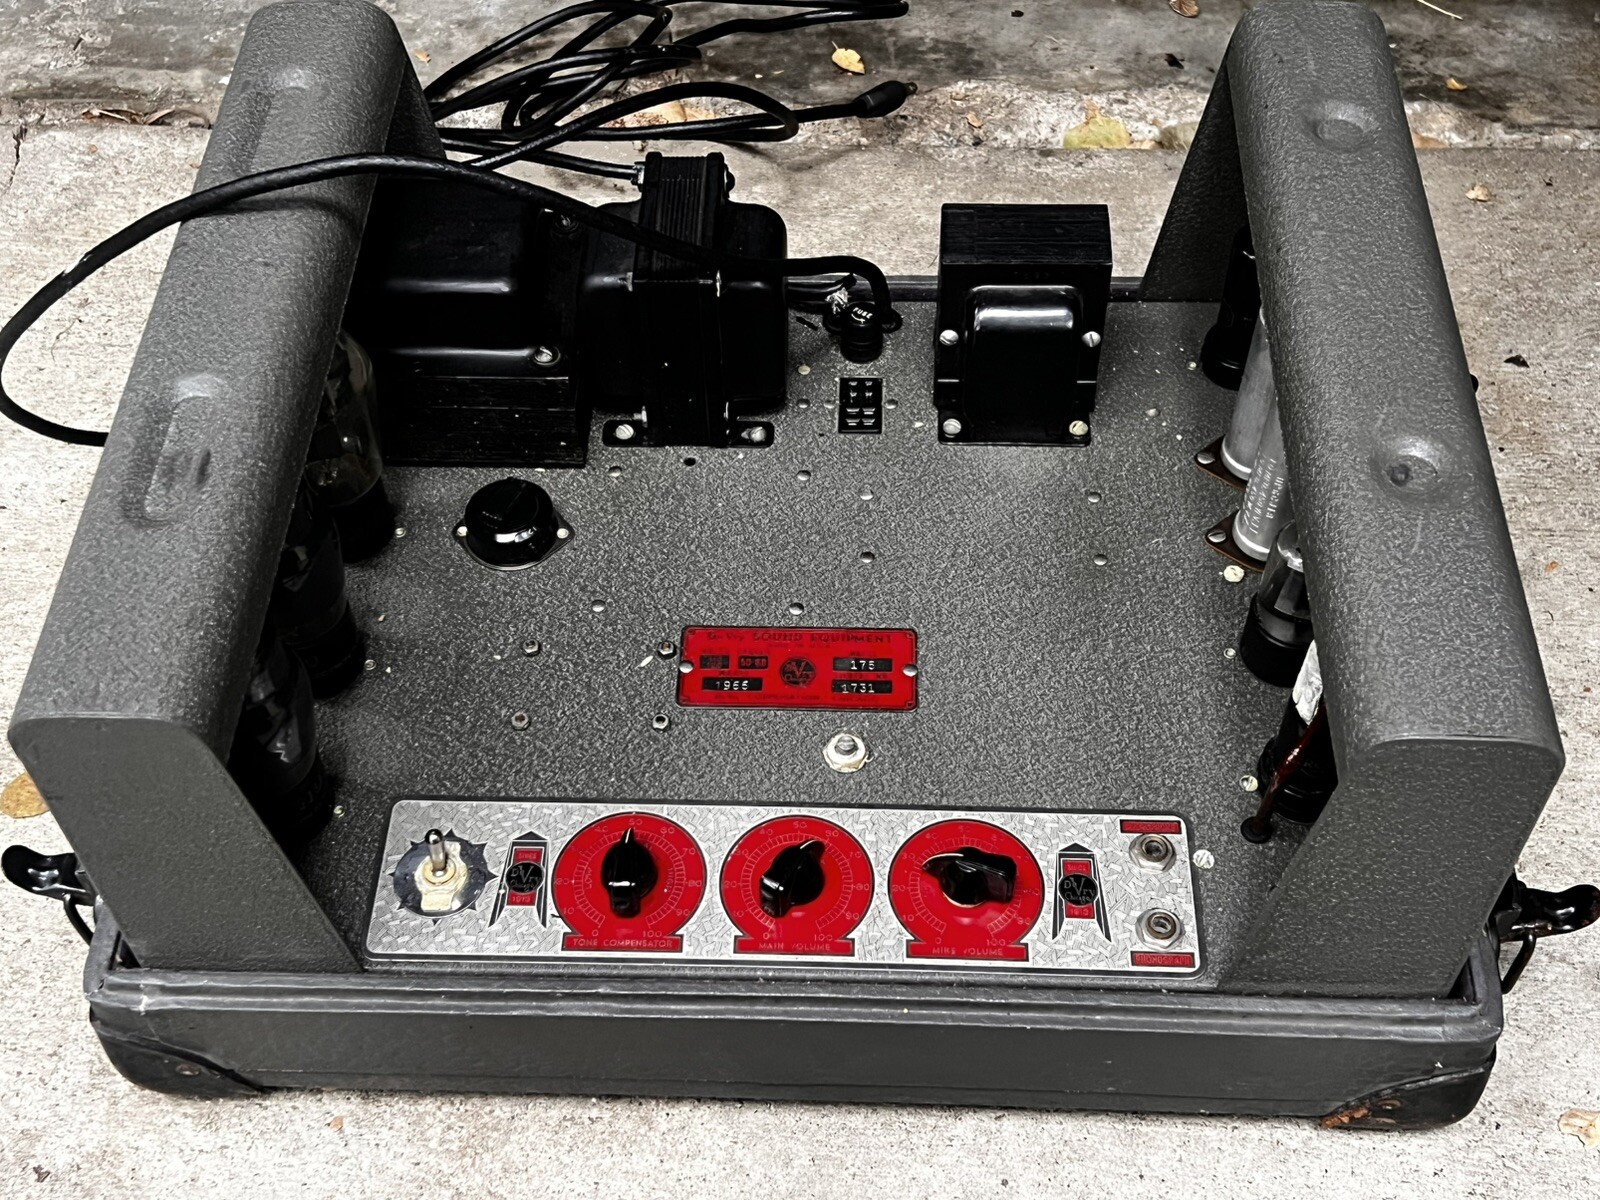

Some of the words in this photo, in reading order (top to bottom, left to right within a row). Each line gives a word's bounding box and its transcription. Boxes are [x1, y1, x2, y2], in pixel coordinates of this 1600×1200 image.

[853, 307, 873, 319] FUSE
[753, 631, 803, 641] SOUND
[810, 632, 892, 643] EQUIPMENT
[850, 660, 876, 671] 175
[841, 683, 876, 694] 1731
[572, 938, 598, 947] TONE
[603, 939, 674, 949] COMPENSATOR
[758, 941, 785, 951] MAIN
[790, 942, 832, 952] VOLUME
[962, 947, 1004, 957] VOLUME
